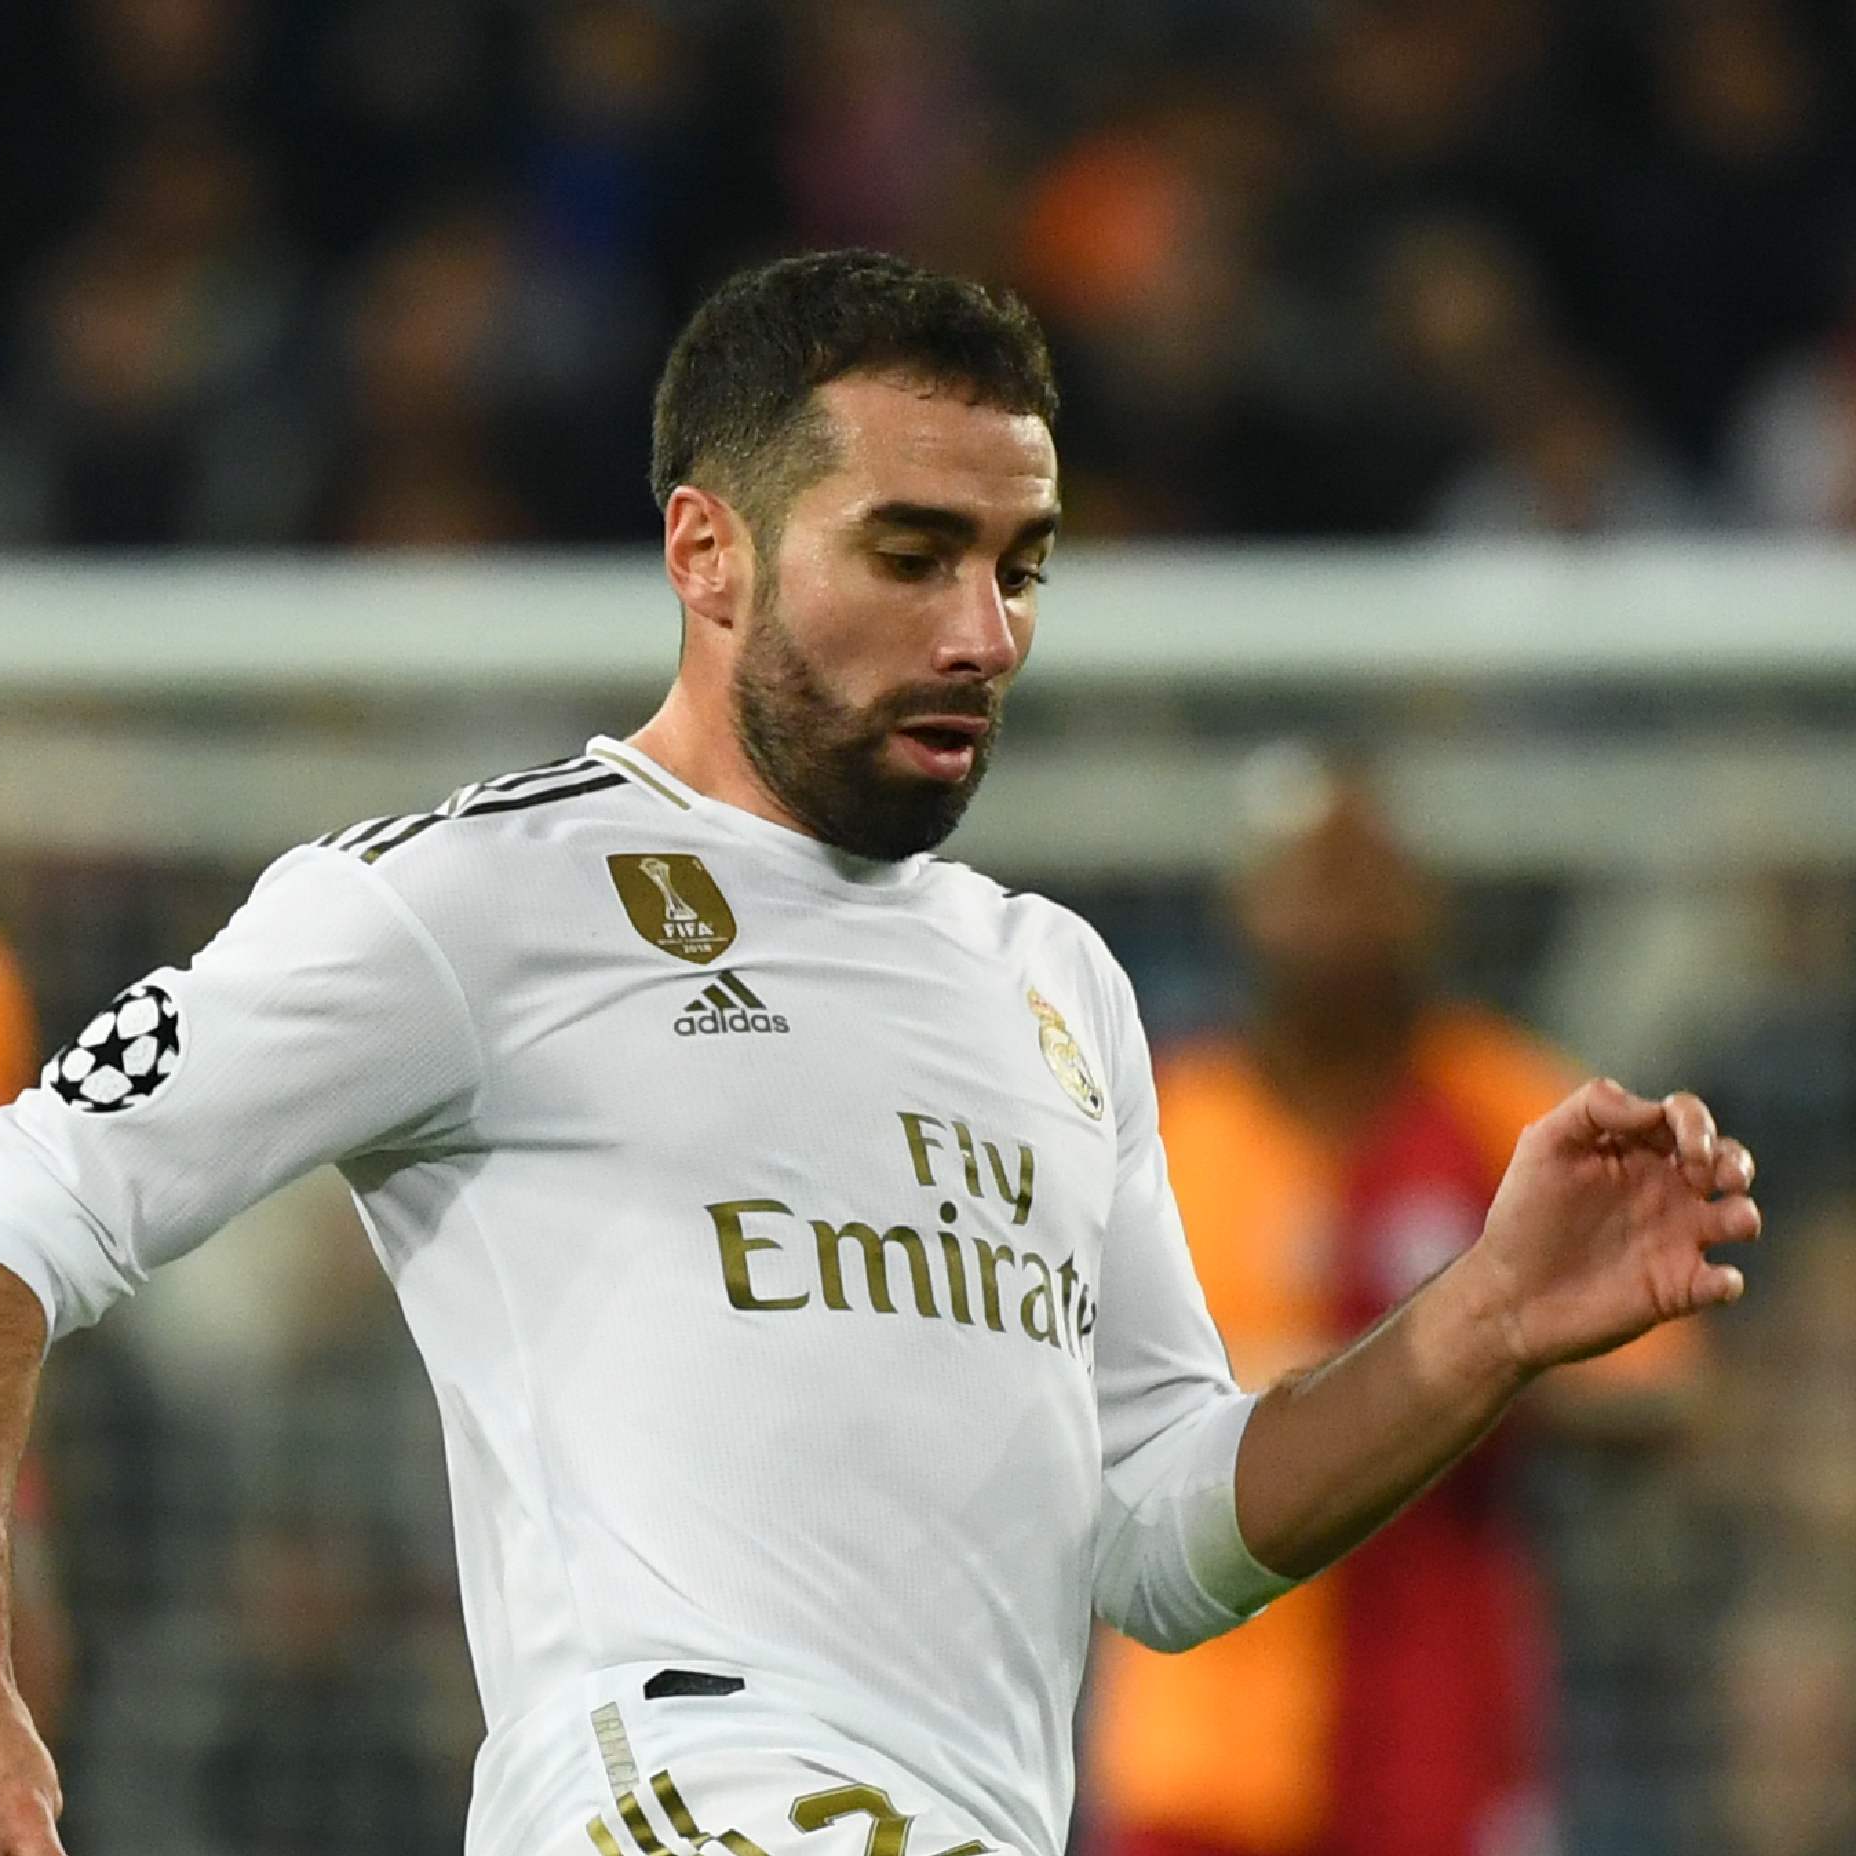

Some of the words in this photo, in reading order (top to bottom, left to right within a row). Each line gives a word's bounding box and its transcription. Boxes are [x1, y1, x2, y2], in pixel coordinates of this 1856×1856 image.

[662, 921, 715, 938] FIFA
[673, 1006, 791, 1037] adidas
[896, 1111, 1035, 1227] Fly
[704, 1199, 1097, 1377] Emirate
